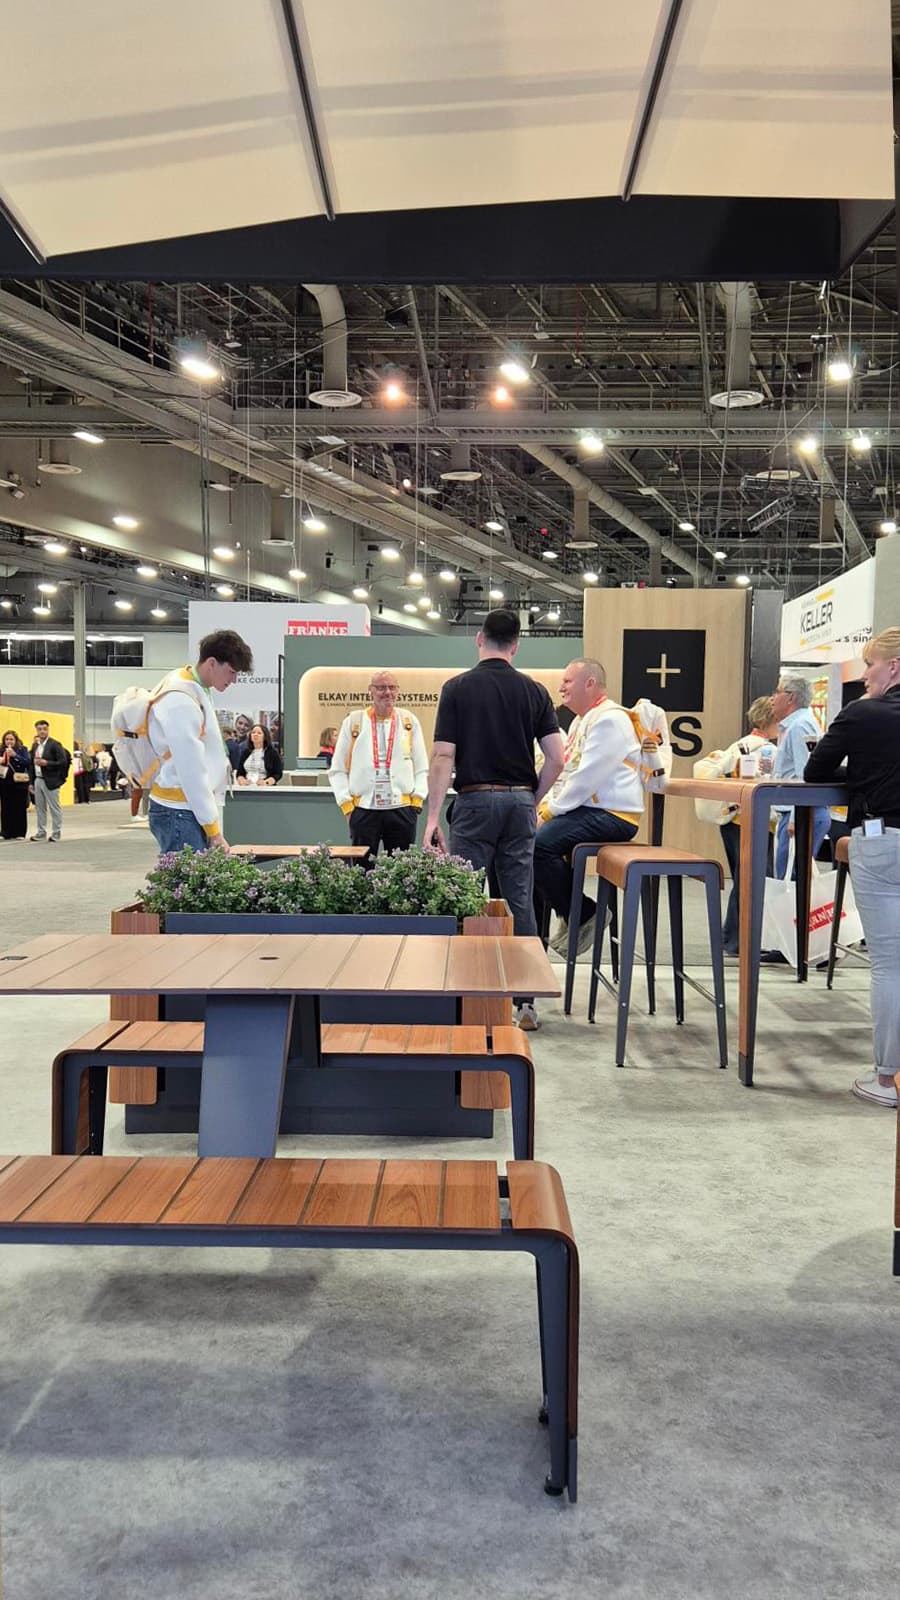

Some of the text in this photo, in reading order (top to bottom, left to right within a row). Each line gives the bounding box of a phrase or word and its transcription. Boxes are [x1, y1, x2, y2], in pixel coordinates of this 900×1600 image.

[800, 601, 833, 634] KELLER
[288, 626, 348, 636] FRANKE
[318, 692, 348, 701] ELKAY
[396, 693, 439, 702] SYSTEMS
